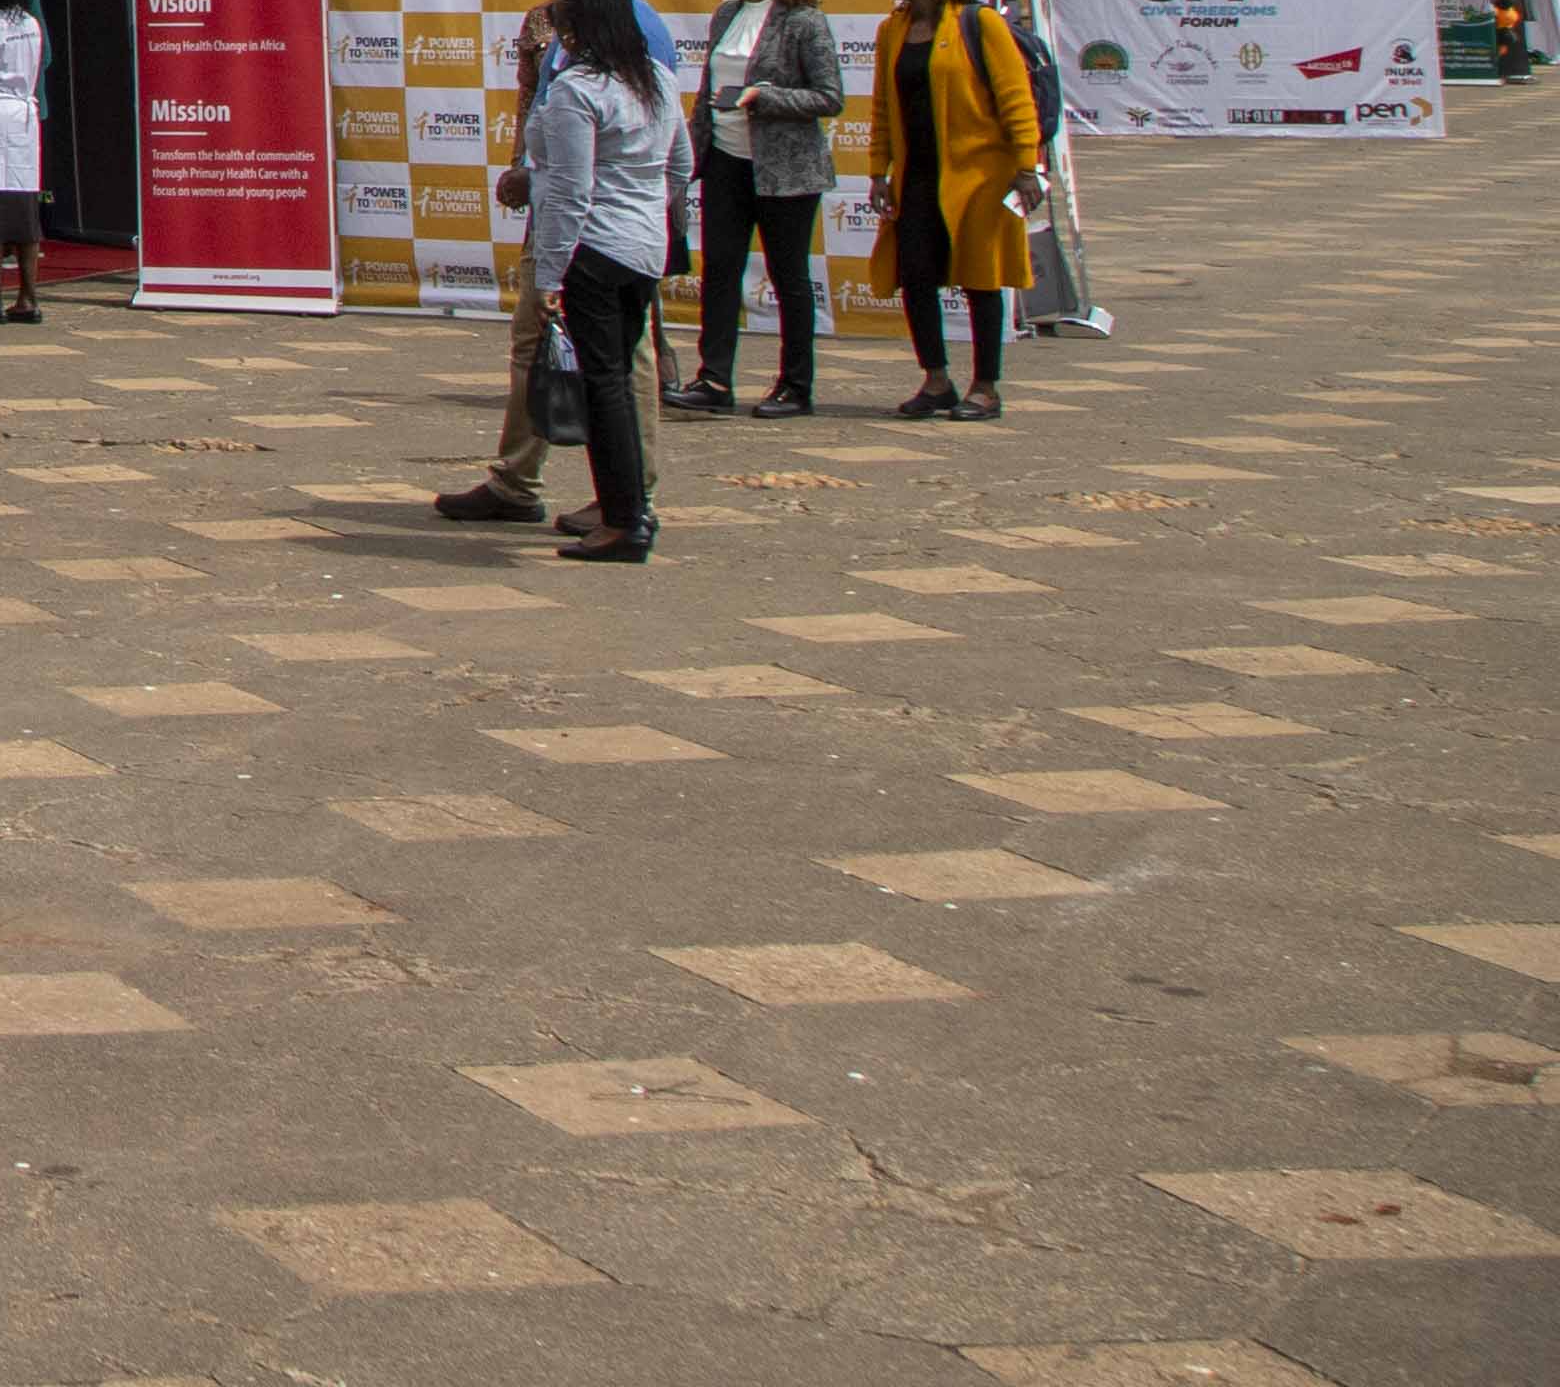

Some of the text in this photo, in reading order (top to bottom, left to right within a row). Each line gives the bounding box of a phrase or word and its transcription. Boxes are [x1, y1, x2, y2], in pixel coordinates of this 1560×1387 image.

[1140, 4, 1278, 17] CIVIC FREEDOMS
[1179, 16, 1239, 27] FORUM
[149, 40, 285, 54] Lasting Health Change in Africa
[152, 100, 230, 122] Mission
[152, 149, 315, 162] Transform the health of communities
[152, 167, 188, 182] through
[190, 168, 224, 182] Primary
[227, 167, 257, 179] Health
[258, 168, 278, 179] Care
[279, 168, 301, 179] with
[152, 186, 307, 200] focus on women and young people
